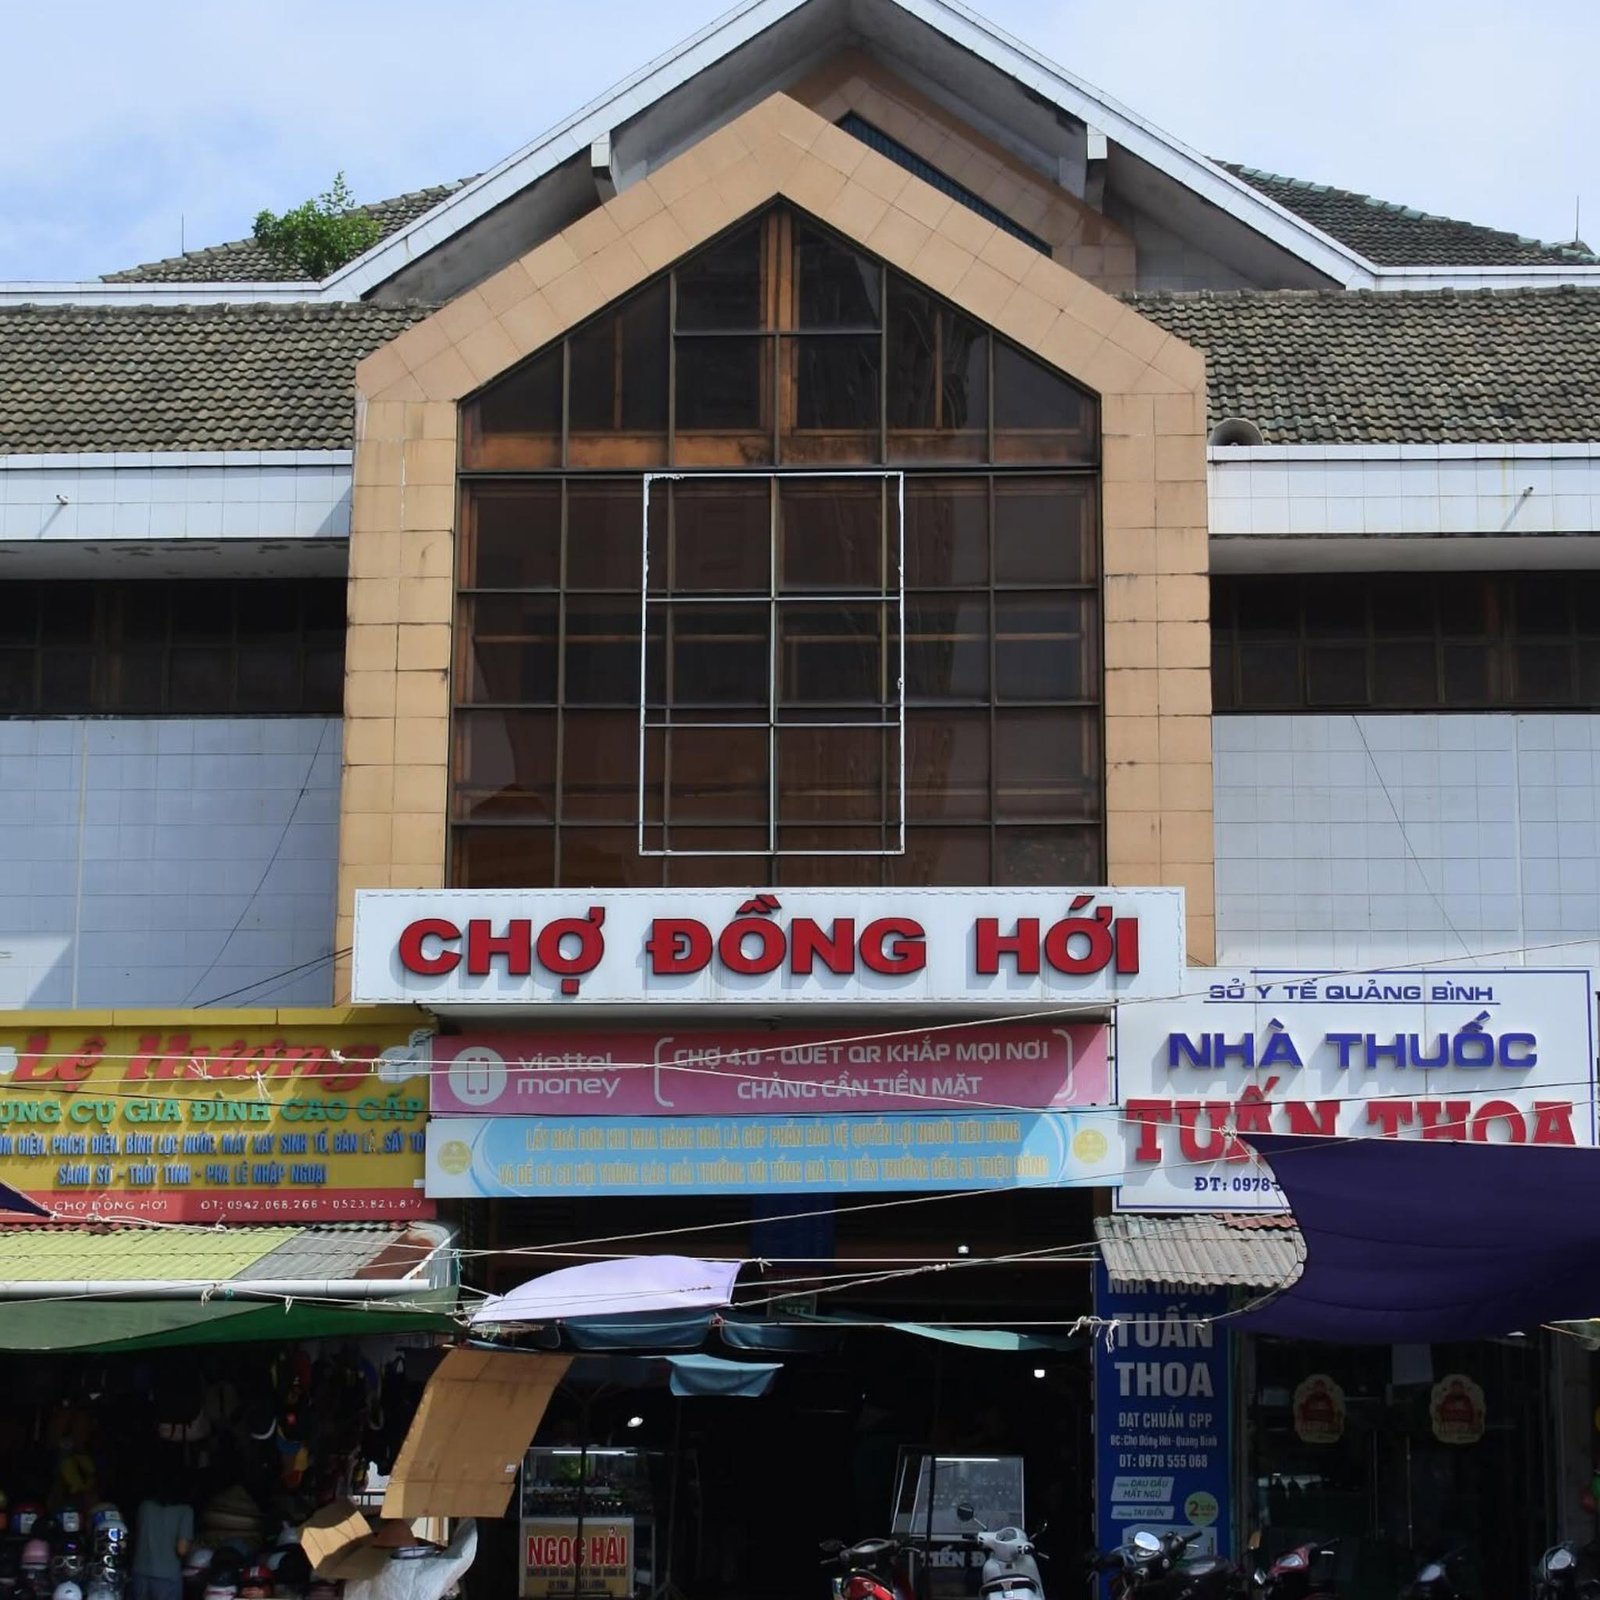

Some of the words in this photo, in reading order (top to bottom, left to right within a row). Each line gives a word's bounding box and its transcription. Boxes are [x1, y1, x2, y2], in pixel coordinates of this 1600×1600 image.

[399, 906, 606, 996] CHỢ
[645, 894, 927, 976] ĐỒNG
[975, 895, 1140, 976] HỚI
[1209, 977, 1246, 1000] SỞ
[1256, 985, 1273, 1000] Y
[1283, 977, 1318, 1001] TẾ
[1326, 979, 1421, 1000] QUẢNG
[1432, 980, 1493, 1001] BÌNH
[673, 1046, 721, 1068] CHỢ
[726, 1047, 761, 1066] 4.0
[848, 1044, 882, 1063] QR
[887, 1034, 951, 1062] KHẮP
[955, 1042, 1001, 1065] MỌI
[1006, 1039, 1049, 1060] NƠI
[1169, 1017, 1304, 1069] NHÀ
[1326, 1010, 1537, 1069] THUỐC
[517, 1051, 617, 1072] viettel
[516, 1076, 622, 1098] money
[821, 1069, 869, 1098] CẦN
[873, 1067, 927, 1096] TIỀN
[932, 1072, 984, 1098] MẶT
[70, 1099, 118, 1129] CỤ
[124, 1099, 183, 1124] GIA
[190, 1089, 272, 1124] ĐÌNH
[280, 1096, 350, 1122] CAO
[356, 1087, 425, 1122] CẤP
[1126, 1075, 1341, 1162] TUẤN
[125, 1130, 155, 1155] BÌNH
[221, 1130, 248, 1155] MÁY
[253, 1133, 275, 1154] XAY
[280, 1133, 308, 1154] SINH
[334, 1129, 358, 1153] BÀN
[383, 1127, 404, 1153] SẤY
[163, 1163, 192, 1184] TINH
[205, 1163, 230, 1184] PHA
[234, 1159, 248, 1184] LÊ
[252, 1159, 286, 1188] NHẬP
[1194, 1176, 1227, 1192] ĐT:
[1112, 1302, 1214, 1348] TUẤN
[1114, 1361, 1215, 1397] THOA
[1119, 1411, 1140, 1431] ĐẠT
[1189, 1413, 1213, 1428] GPP
[1138, 1454, 1165, 1468] 0978
[1167, 1454, 1187, 1468] 555
[1189, 1454, 1208, 1468] 068
[1190, 1500, 1199, 1517] 2
[590, 1526, 627, 1566] HẢI
